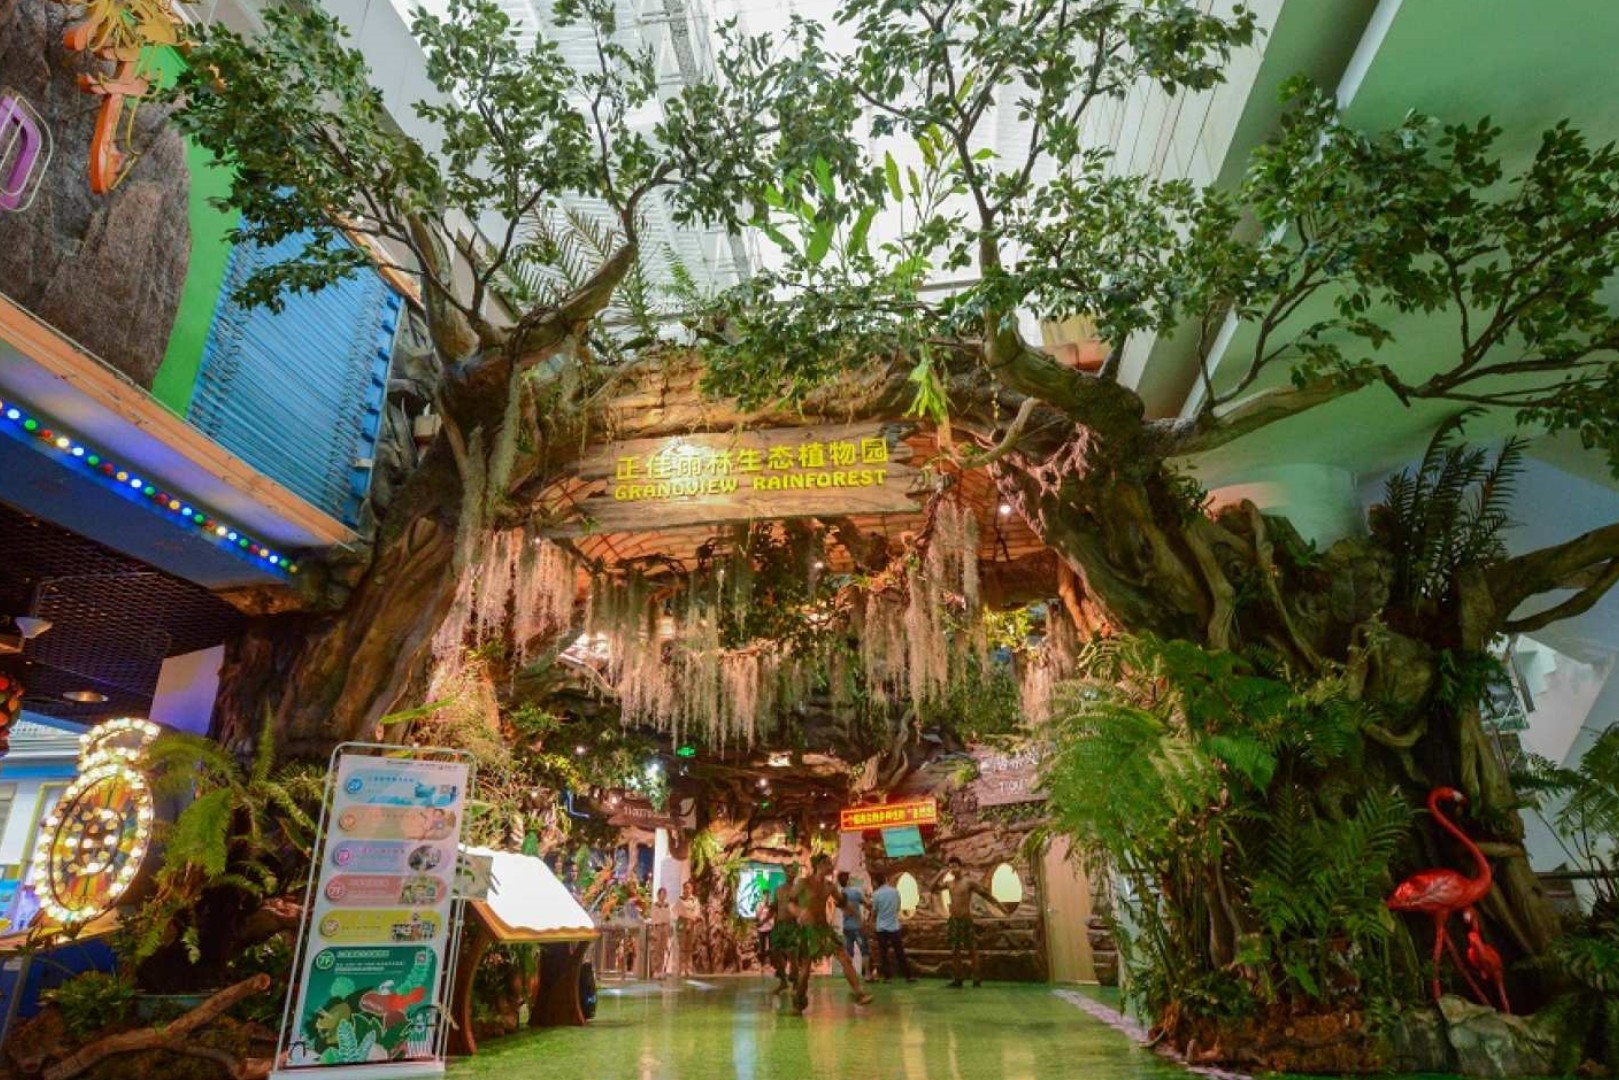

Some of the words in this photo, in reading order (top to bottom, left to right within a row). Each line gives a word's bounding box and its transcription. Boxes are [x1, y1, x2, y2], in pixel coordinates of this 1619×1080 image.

[616, 437, 889, 480] 正佳雨林生态植物园
[615, 477, 739, 500] GRANDVIEW
[753, 469, 887, 490] RAINFOREST
